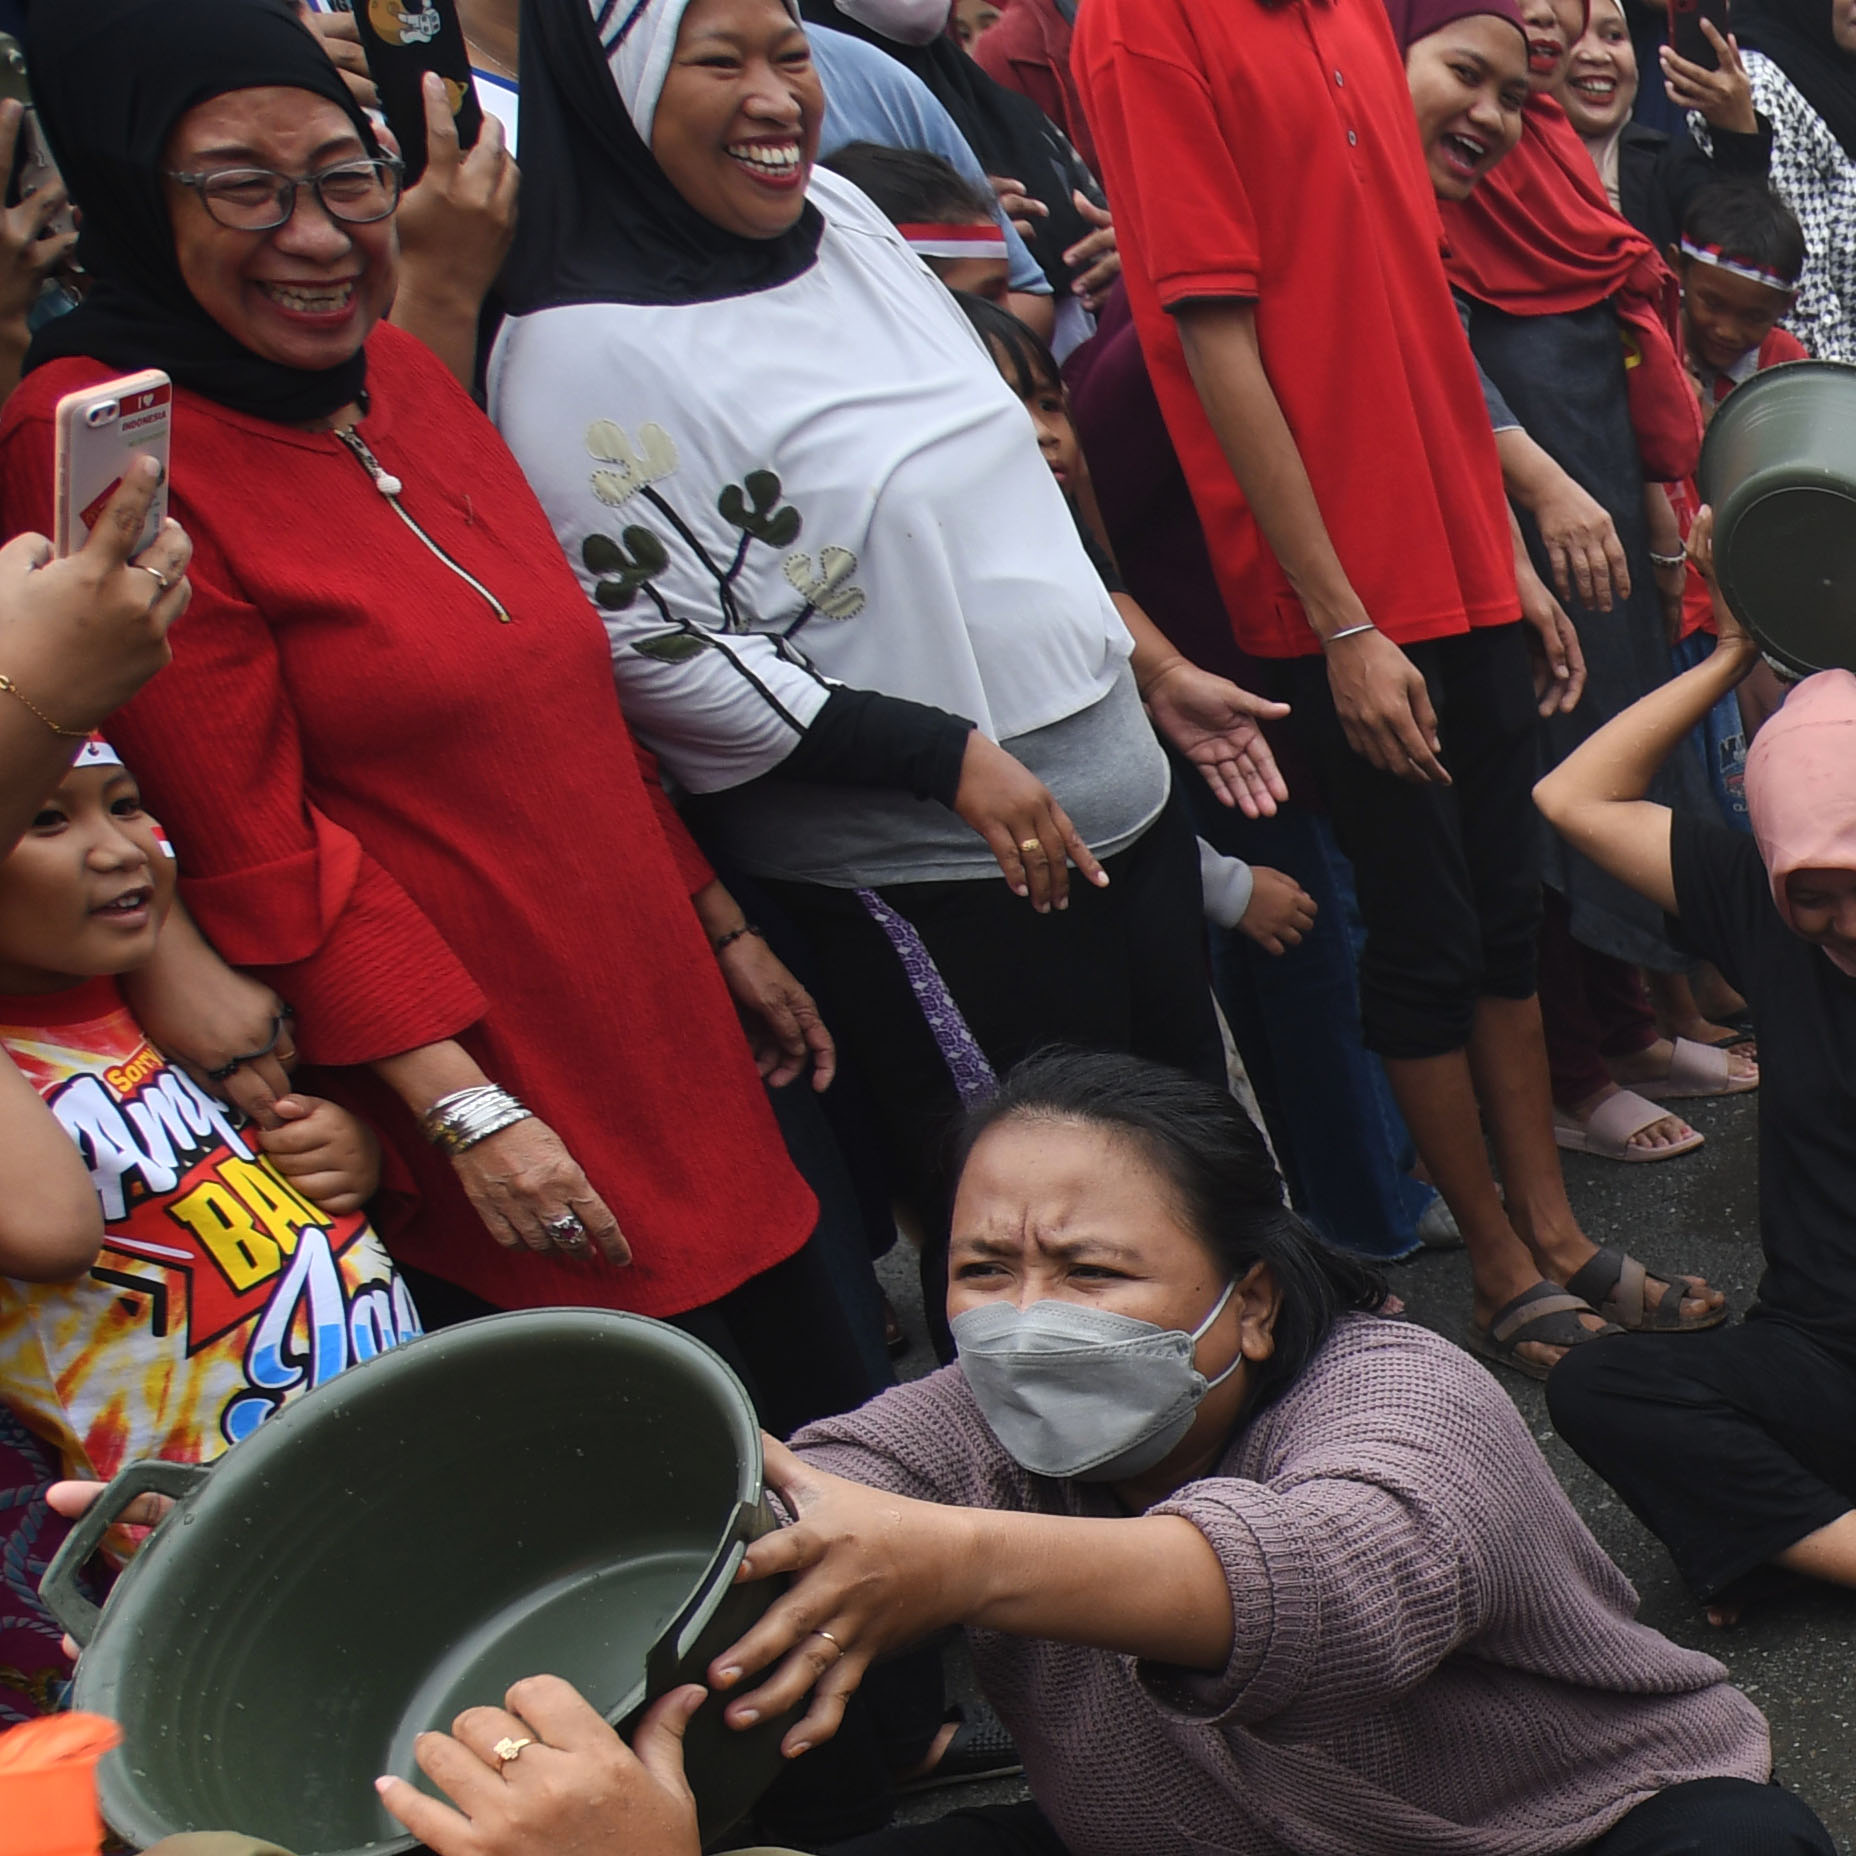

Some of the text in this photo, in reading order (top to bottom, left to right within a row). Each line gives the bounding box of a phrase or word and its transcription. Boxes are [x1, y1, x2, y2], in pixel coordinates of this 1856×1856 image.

[121, 410, 167, 432] INDONESIA
[107, 1047, 164, 1092] Sorry
[169, 1150, 332, 1291] BA
